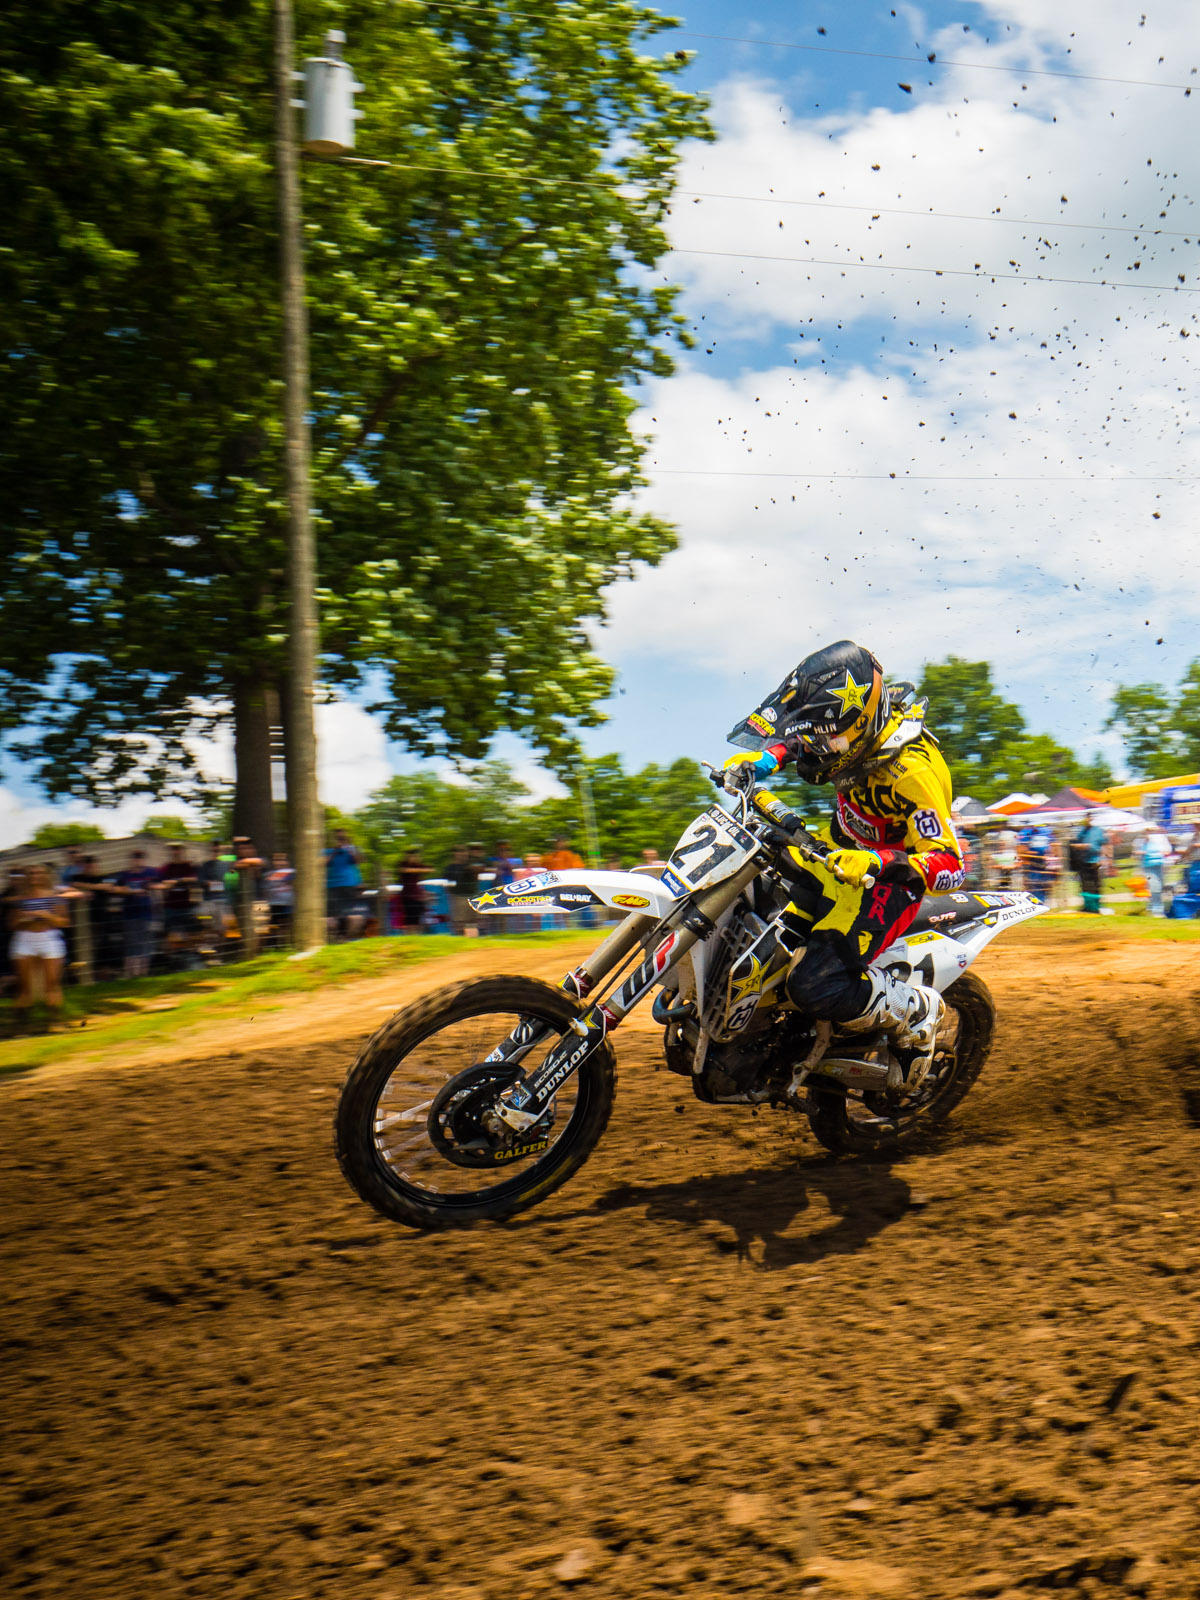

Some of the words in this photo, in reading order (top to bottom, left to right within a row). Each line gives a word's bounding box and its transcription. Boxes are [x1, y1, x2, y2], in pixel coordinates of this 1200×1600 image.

[785, 721, 812, 736] Airoh
[715, 813, 733, 830] LUC
[728, 825, 740, 838] OIL
[670, 824, 737, 885] 21
[1002, 906, 1037, 921] DUNLOP
[536, 1041, 589, 1102] DUNLOP
[494, 1141, 547, 1160] GALFER
